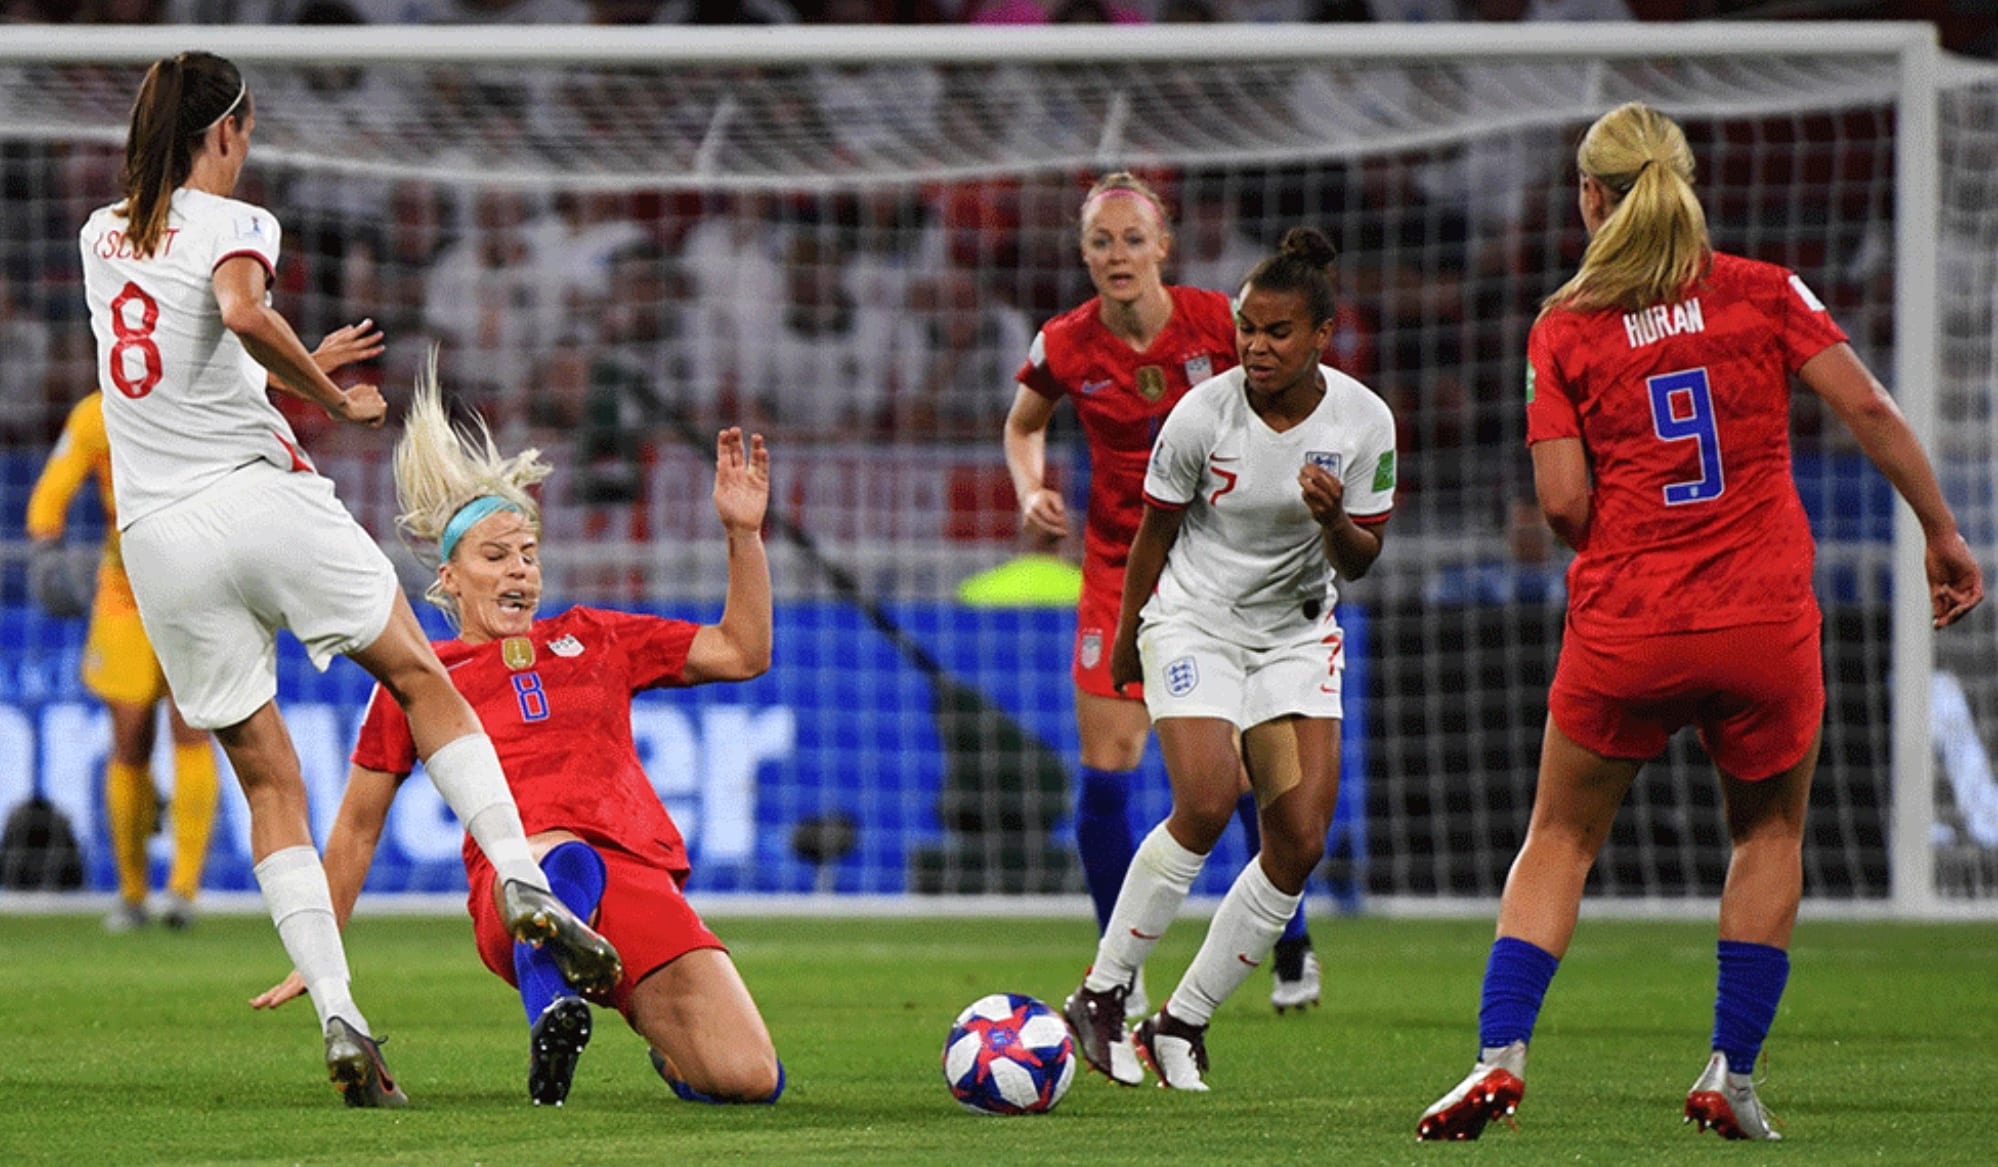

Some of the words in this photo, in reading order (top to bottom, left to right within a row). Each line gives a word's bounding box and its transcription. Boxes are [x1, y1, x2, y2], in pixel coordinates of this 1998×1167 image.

[102, 227, 180, 260] SCT
[110, 281, 163, 399] 8
[1646, 367, 1725, 506] 9
[1210, 466, 1237, 506] 7
[511, 671, 550, 723] 8
